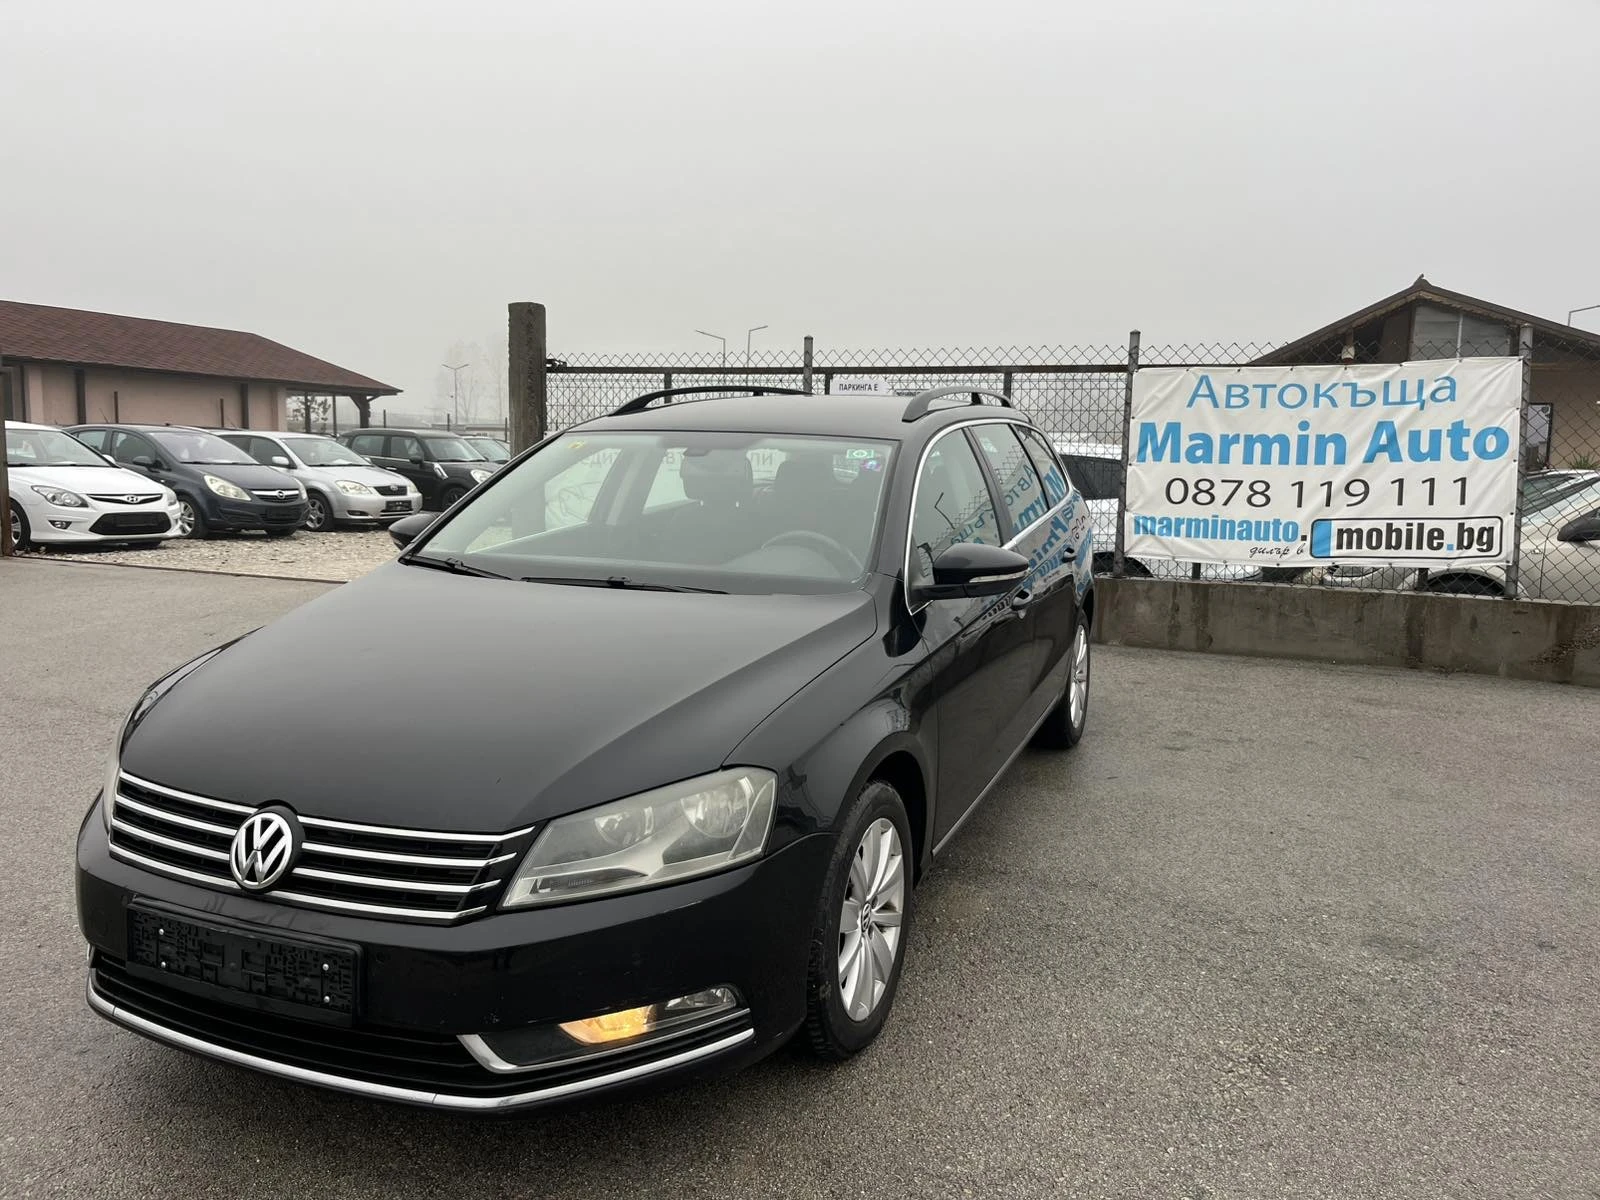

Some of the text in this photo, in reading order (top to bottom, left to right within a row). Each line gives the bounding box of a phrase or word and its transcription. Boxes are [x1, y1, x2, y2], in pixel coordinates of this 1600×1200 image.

[839, 383, 872, 392] ПАРКИНГА
[1186, 374, 1457, 411] Автокъща
[1136, 419, 1510, 465] Marmin Auto
[1165, 477, 1467, 508] 0878 119 111
[1336, 522, 1495, 552] mobile.bg
